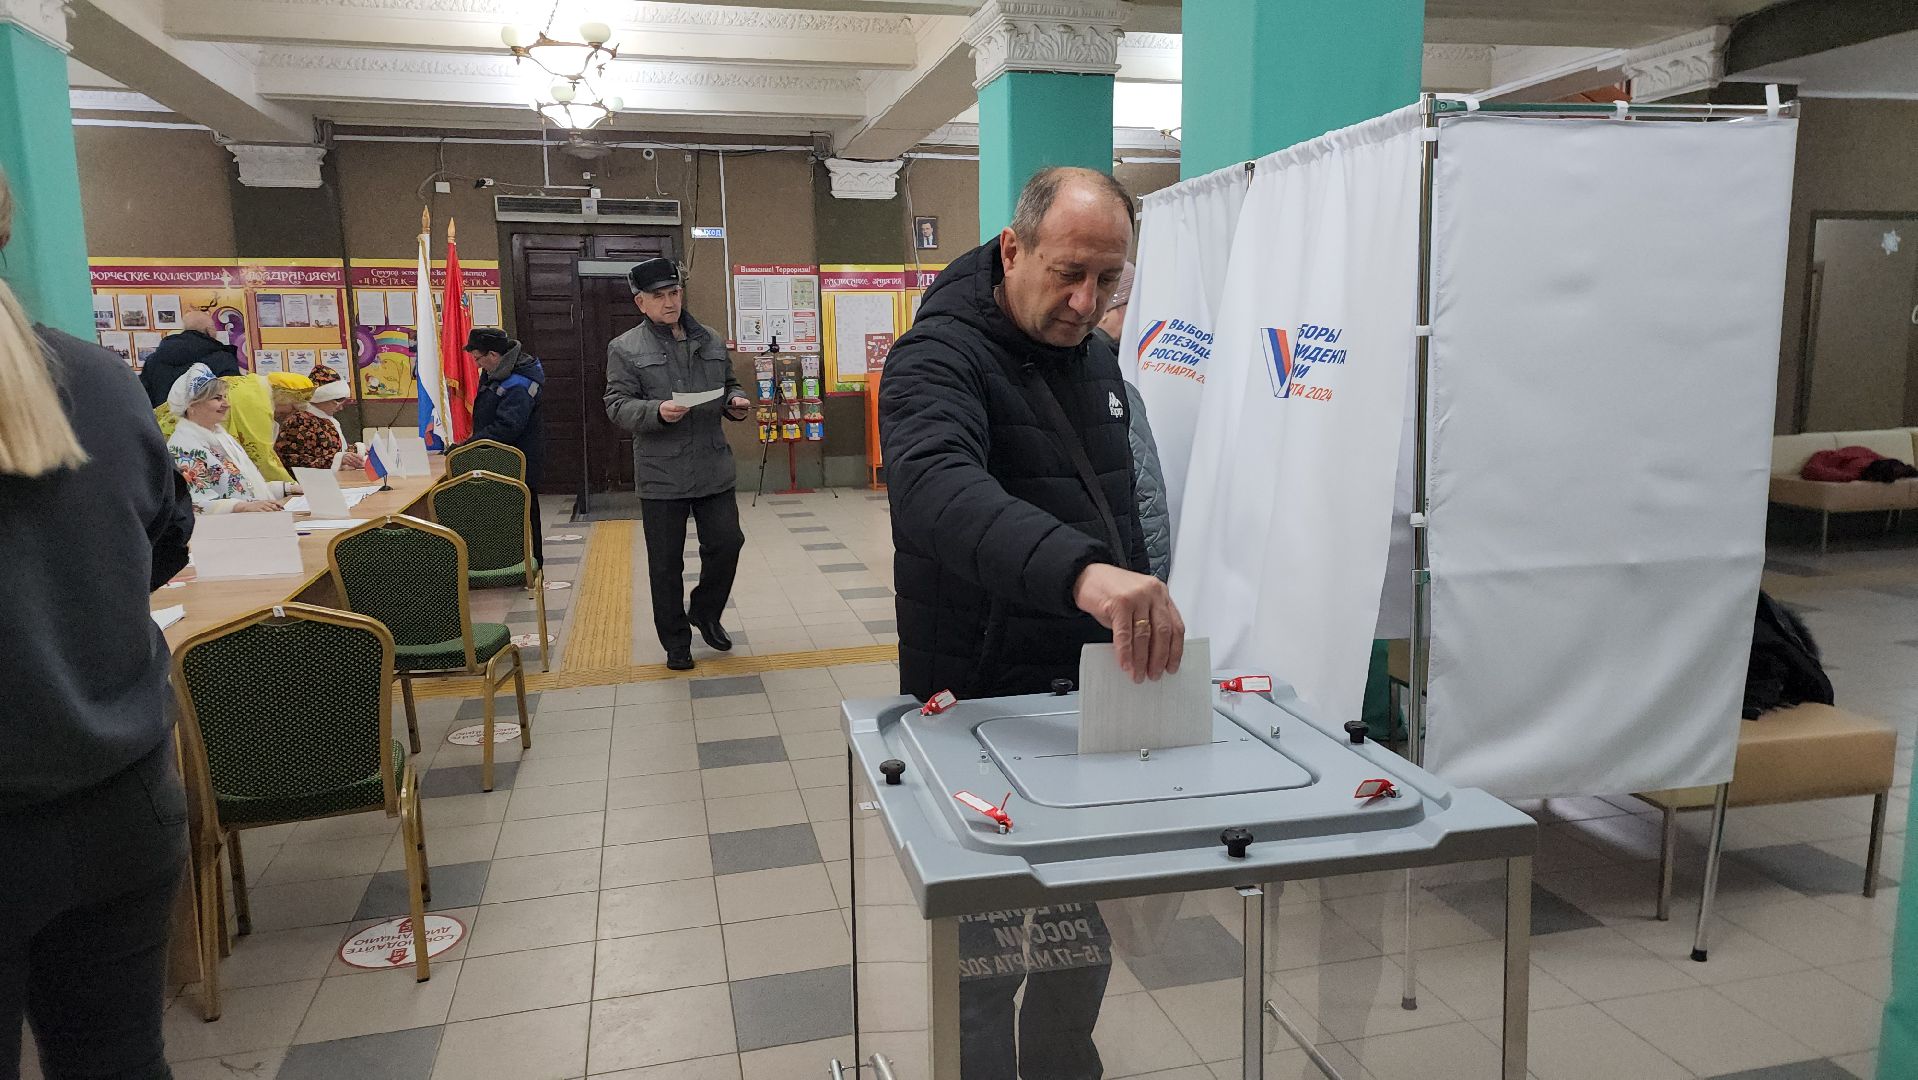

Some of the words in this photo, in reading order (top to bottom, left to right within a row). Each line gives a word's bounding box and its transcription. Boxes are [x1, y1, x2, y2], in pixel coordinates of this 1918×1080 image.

[89, 271, 152, 282] ВОРЧЕСКИЕ
[153, 271, 221, 282] КОЛЛЕКТИВЫ
[245, 271, 340, 284] ПОЗДРАВЛЯЕМ!
[1148, 348, 1200, 366] РОССИИ
[1164, 363, 1198, 379] МАРТА
[1304, 386, 1333, 402] 2024
[353, 926, 452, 946] ДИСАНЦИЮ
[346, 934, 455, 955] СОБЮДАЙТЕ
